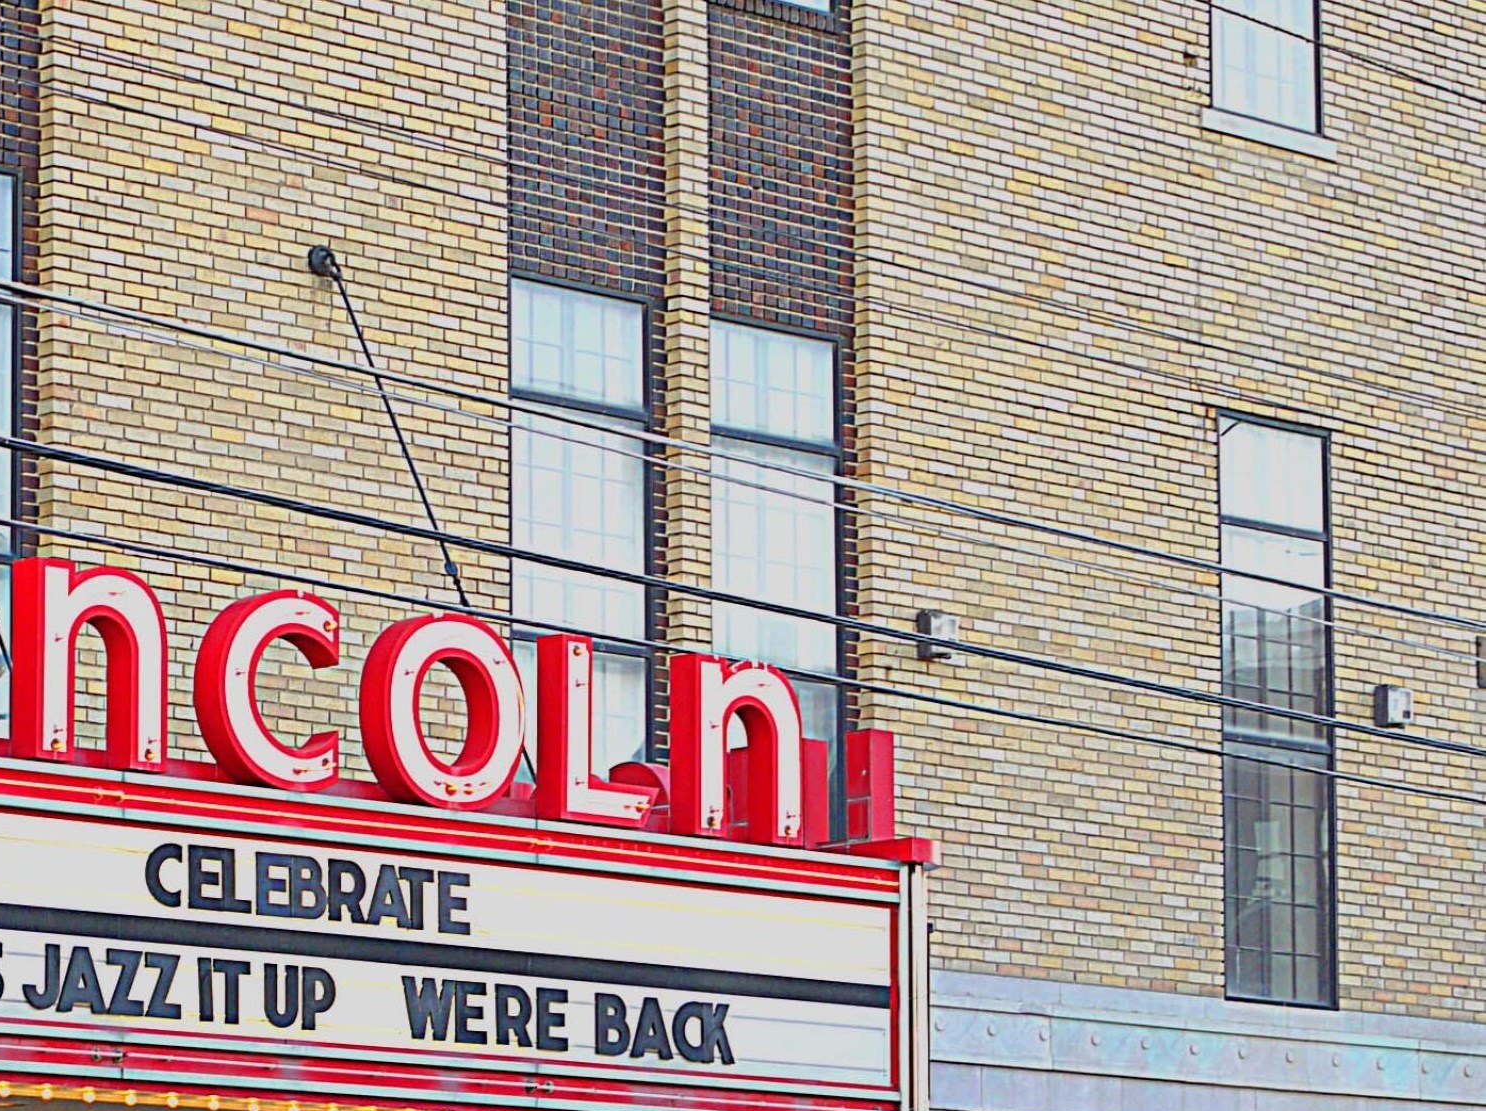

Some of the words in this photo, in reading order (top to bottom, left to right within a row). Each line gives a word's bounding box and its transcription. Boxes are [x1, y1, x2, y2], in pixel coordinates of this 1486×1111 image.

[144, 843, 471, 935] CELEBRATE
[22, 943, 181, 1019] JAZZ
[196, 957, 251, 1025] IT
[264, 963, 336, 1030] UP
[402, 975, 569, 1051] WERE
[594, 991, 735, 1066] BACK
